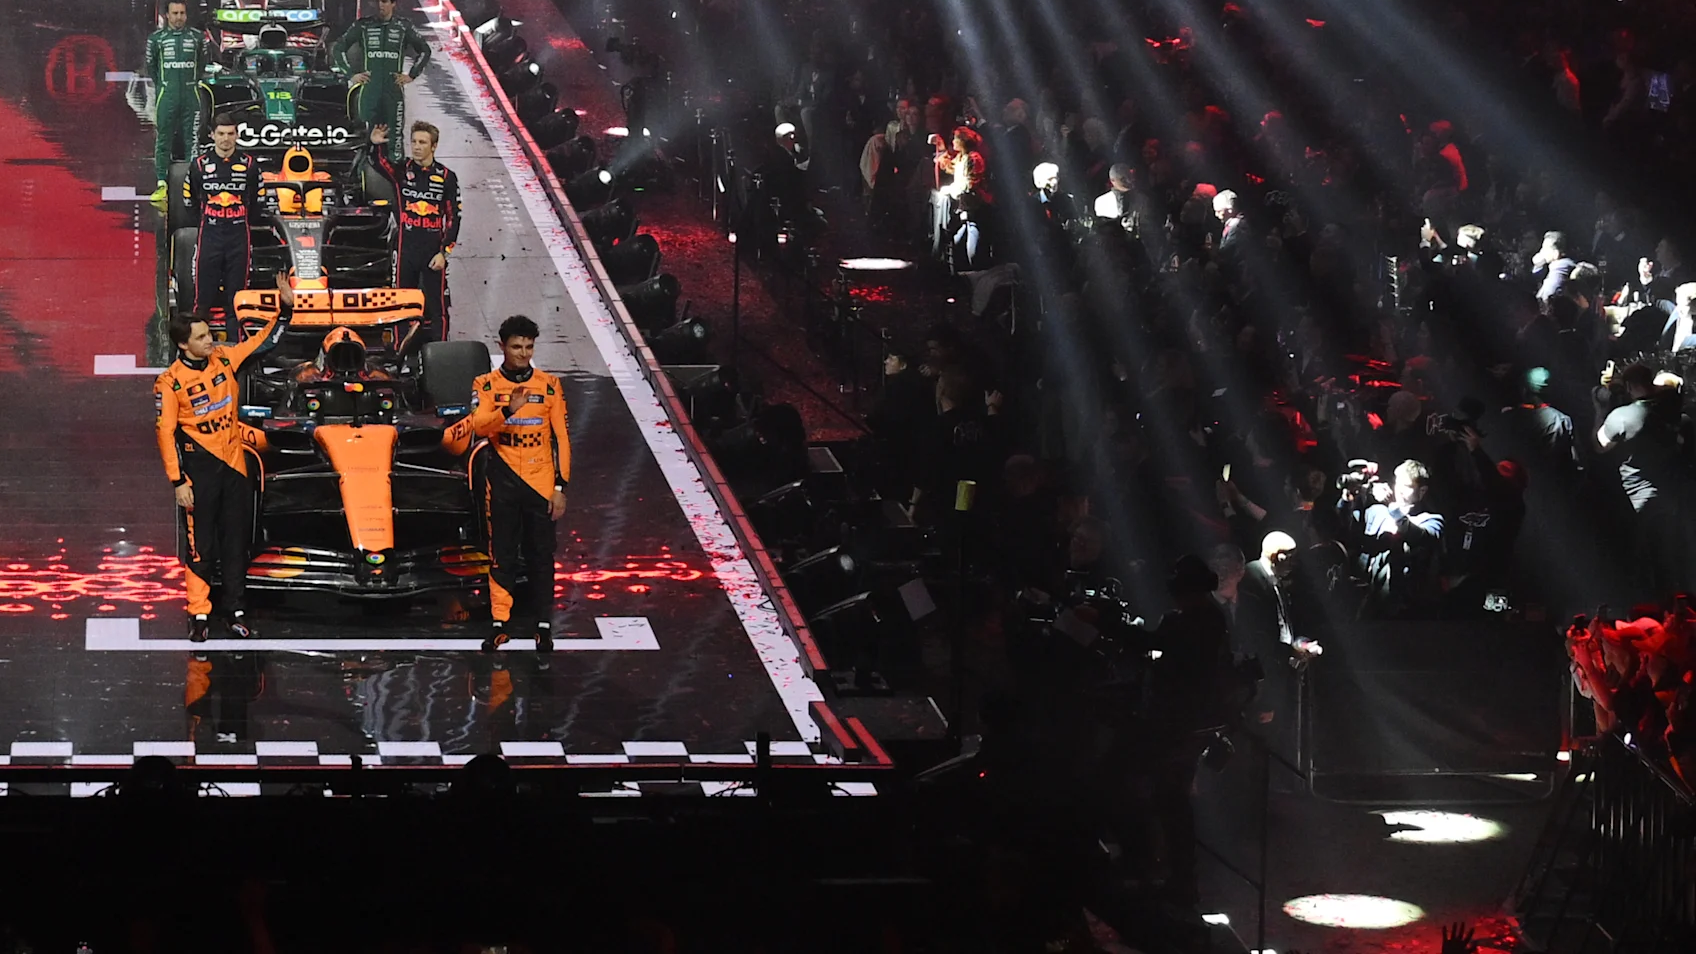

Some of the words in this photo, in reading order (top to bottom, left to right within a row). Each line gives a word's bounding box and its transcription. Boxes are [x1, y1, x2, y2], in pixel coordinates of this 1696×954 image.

[367, 51, 399, 59] aramco
[164, 61, 195, 69] aramco
[203, 182, 246, 190] ORACLE
[402, 188, 443, 201] ORACLE
[204, 204, 224, 218] Red
[225, 205, 246, 218] Bull
[401, 212, 421, 227] Red
[422, 217, 442, 229] Bull
